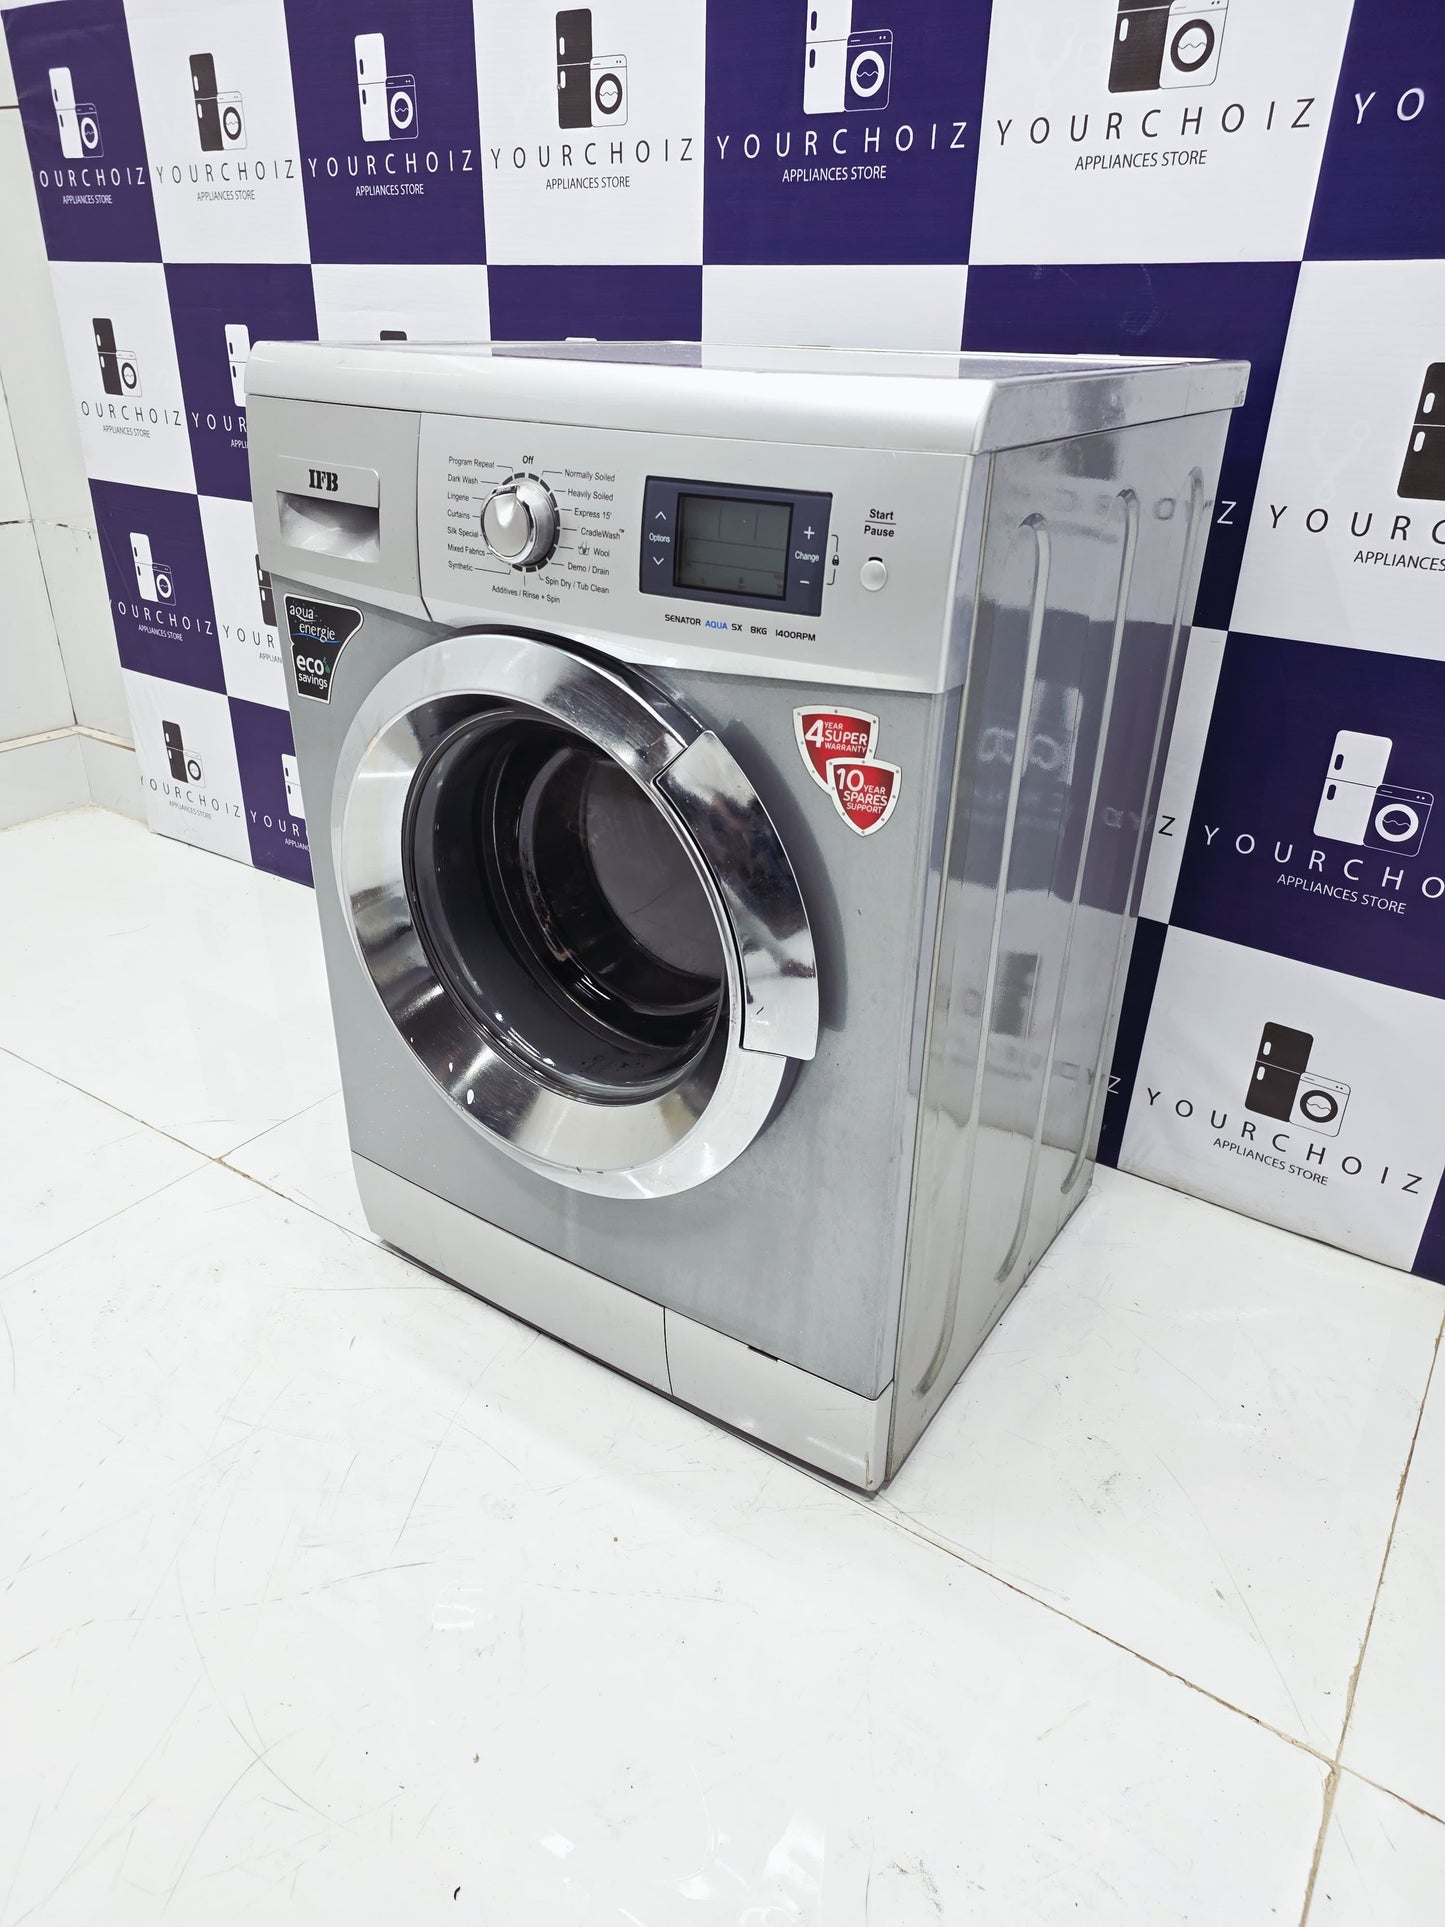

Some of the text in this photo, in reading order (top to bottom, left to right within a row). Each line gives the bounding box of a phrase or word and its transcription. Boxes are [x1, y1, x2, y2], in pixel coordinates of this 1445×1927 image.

[997, 98, 1316, 146] YOURCHOIZ
[717, 122, 968, 160] YOURCHOIZ
[490, 138, 693, 169] YOURCHOIZ
[1075, 149, 1208, 171] APPLIANCES STORE
[156, 159, 295, 183] YOURCHOIZ
[308, 149, 474, 178] YOURCHOIZ
[782, 165, 887, 183] APPLIANCES STORE
[355, 183, 425, 197] APPLIANCES STORE
[545, 175, 630, 190] APPLIANCES STORE
[62, 194, 113, 204] APPLIANCES STORE
[197, 189, 255, 202] APPLIANCES STORE
[102, 425, 150, 439] APPLIANCES STORE
[448, 456, 495, 469] Program Repeat
[522, 455, 534, 464] Off
[308, 469, 338, 492] IFB
[447, 474, 478, 484] Dark Wash
[565, 469, 615, 482] Normally Soiled
[447, 492, 470, 502] Lingerie
[568, 488, 614, 501] Heavily Soiled
[447, 509, 470, 519] Curtains
[574, 508, 600, 519] Express
[869, 508, 894, 520] Start
[447, 526, 479, 538] Silk Special
[648, 533, 671, 544] Options
[864, 525, 895, 538] Pause
[447, 543, 485, 556] Mixed Fabrics
[593, 548, 610, 557] Wool
[794, 551, 819, 562] Change
[448, 560, 473, 572] Synthetic
[568, 562, 586, 571] Demo
[592, 566, 610, 575] Drain
[545, 576, 559, 587] Spin
[561, 578, 572, 589] Dry
[577, 581, 589, 591] Tub
[590, 584, 610, 594] Clean
[491, 585, 518, 596] Additives
[522, 590, 540, 599] Rinse
[546, 594, 560, 604] Spin
[138, 624, 183, 642] APPLIANCES STORE
[299, 621, 336, 643] energie
[664, 613, 816, 642] SENATOR AQUA SX 8KG 1400RPM
[296, 655, 324, 676] eco
[298, 672, 328, 690] savings
[805, 719, 843, 748] 4 YEAR
[824, 730, 868, 746] SUPER
[824, 741, 867, 753] WARRANTY
[837, 768, 886, 795] 10 YEAR
[843, 791, 888, 806] SPARES
[847, 802, 883, 814] SUPPORT
[1158, 815, 1176, 836] Z
[1204, 824, 1445, 899] YOURCHO
[1277, 873, 1407, 915] APPLIANCES STORE
[1147, 1087, 1423, 1194] YOURCHOIZ
[1213, 1137, 1329, 1186] APPLIANCES STORE
